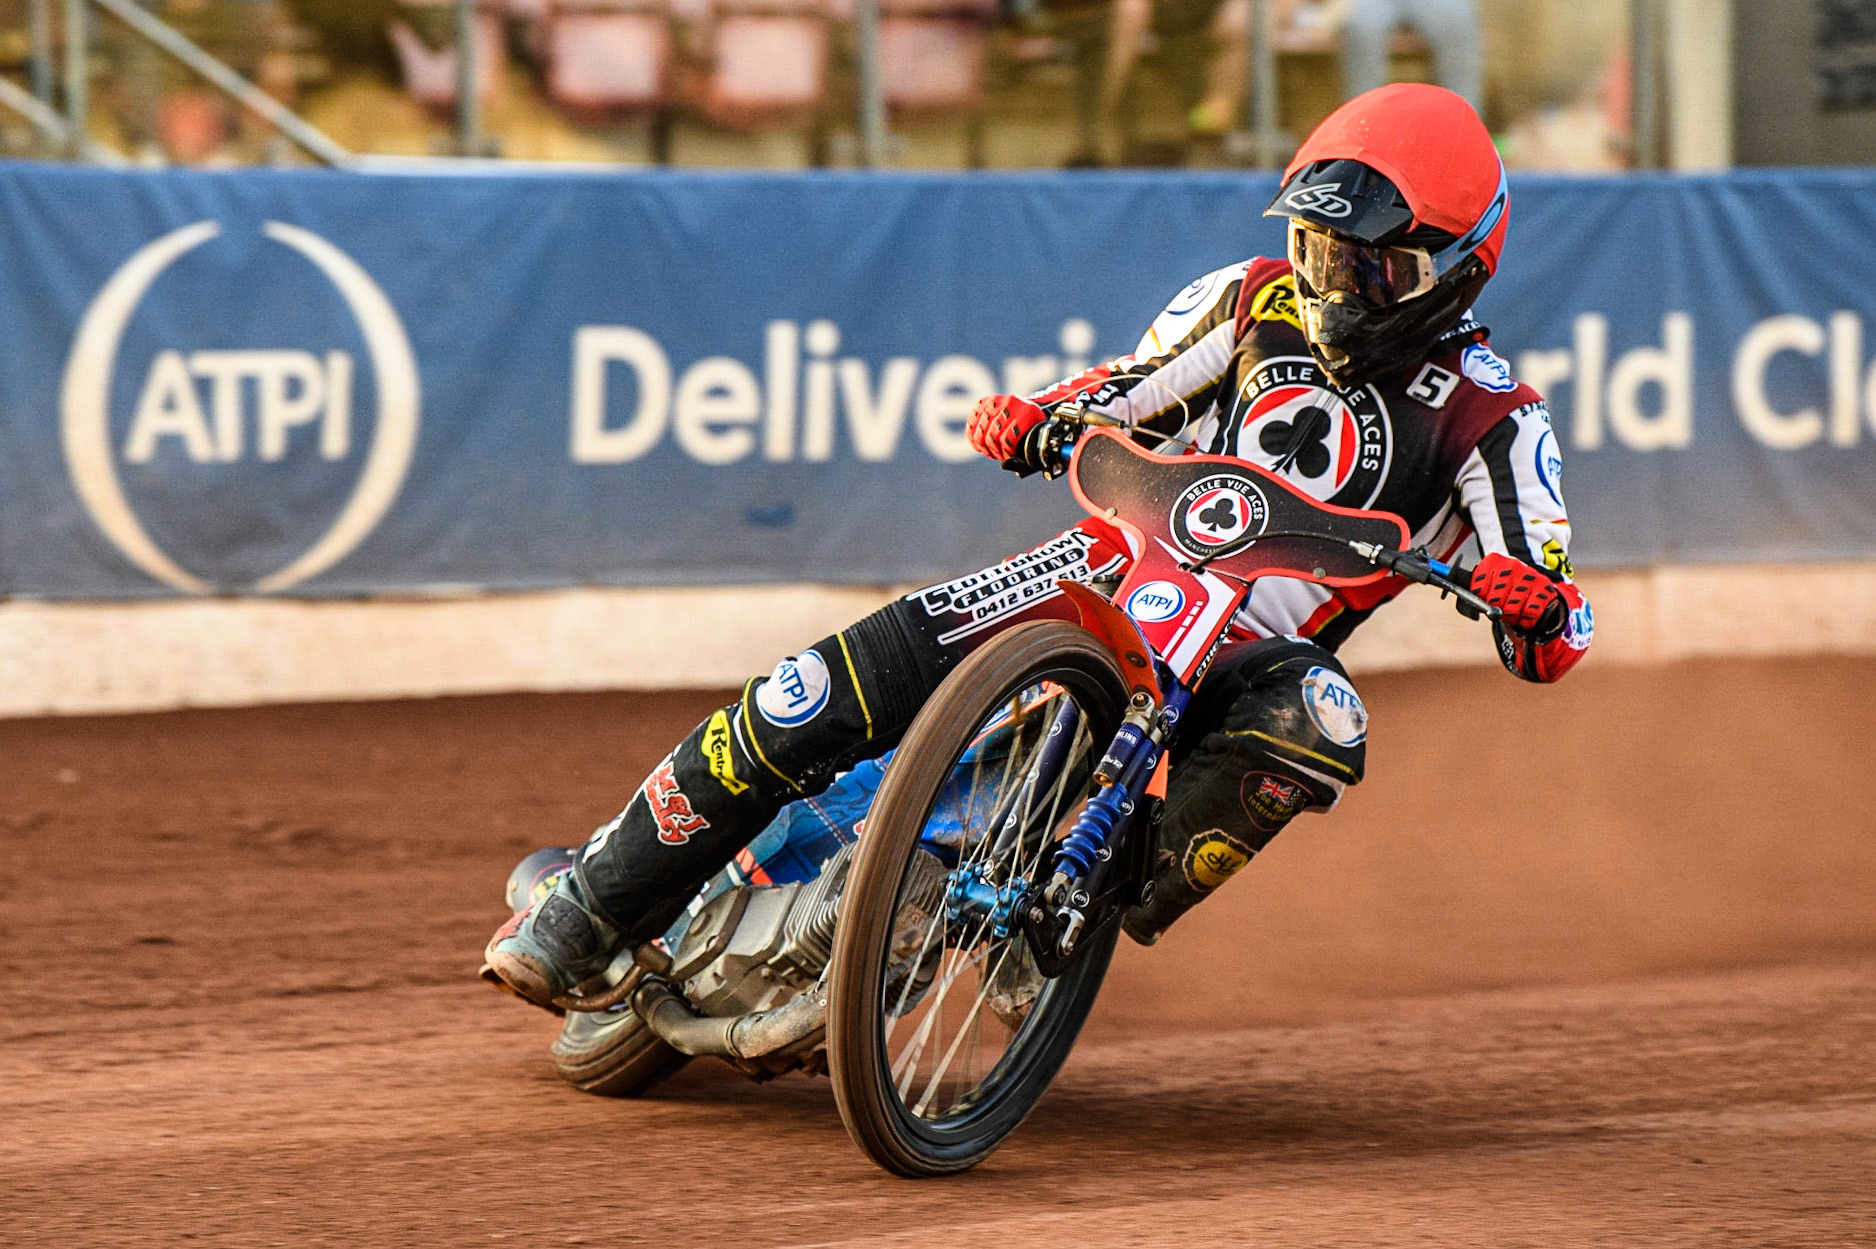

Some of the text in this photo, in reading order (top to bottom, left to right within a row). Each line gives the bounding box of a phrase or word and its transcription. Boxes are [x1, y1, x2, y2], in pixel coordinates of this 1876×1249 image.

[1420, 367, 1451, 403] 5
[1732, 308, 1876, 451] Cl
[126, 350, 353, 463] ATPI
[1245, 365, 1315, 399] BELLE
[1358, 413, 1382, 472] ACES
[1186, 479, 1264, 521] BELLE VUE ACES
[960, 549, 1080, 608] FLOORING
[976, 592, 1019, 621] 0412
[1023, 577, 1053, 599] 637
[1136, 593, 1174, 611] ATPI
[778, 663, 809, 709] ATPI
